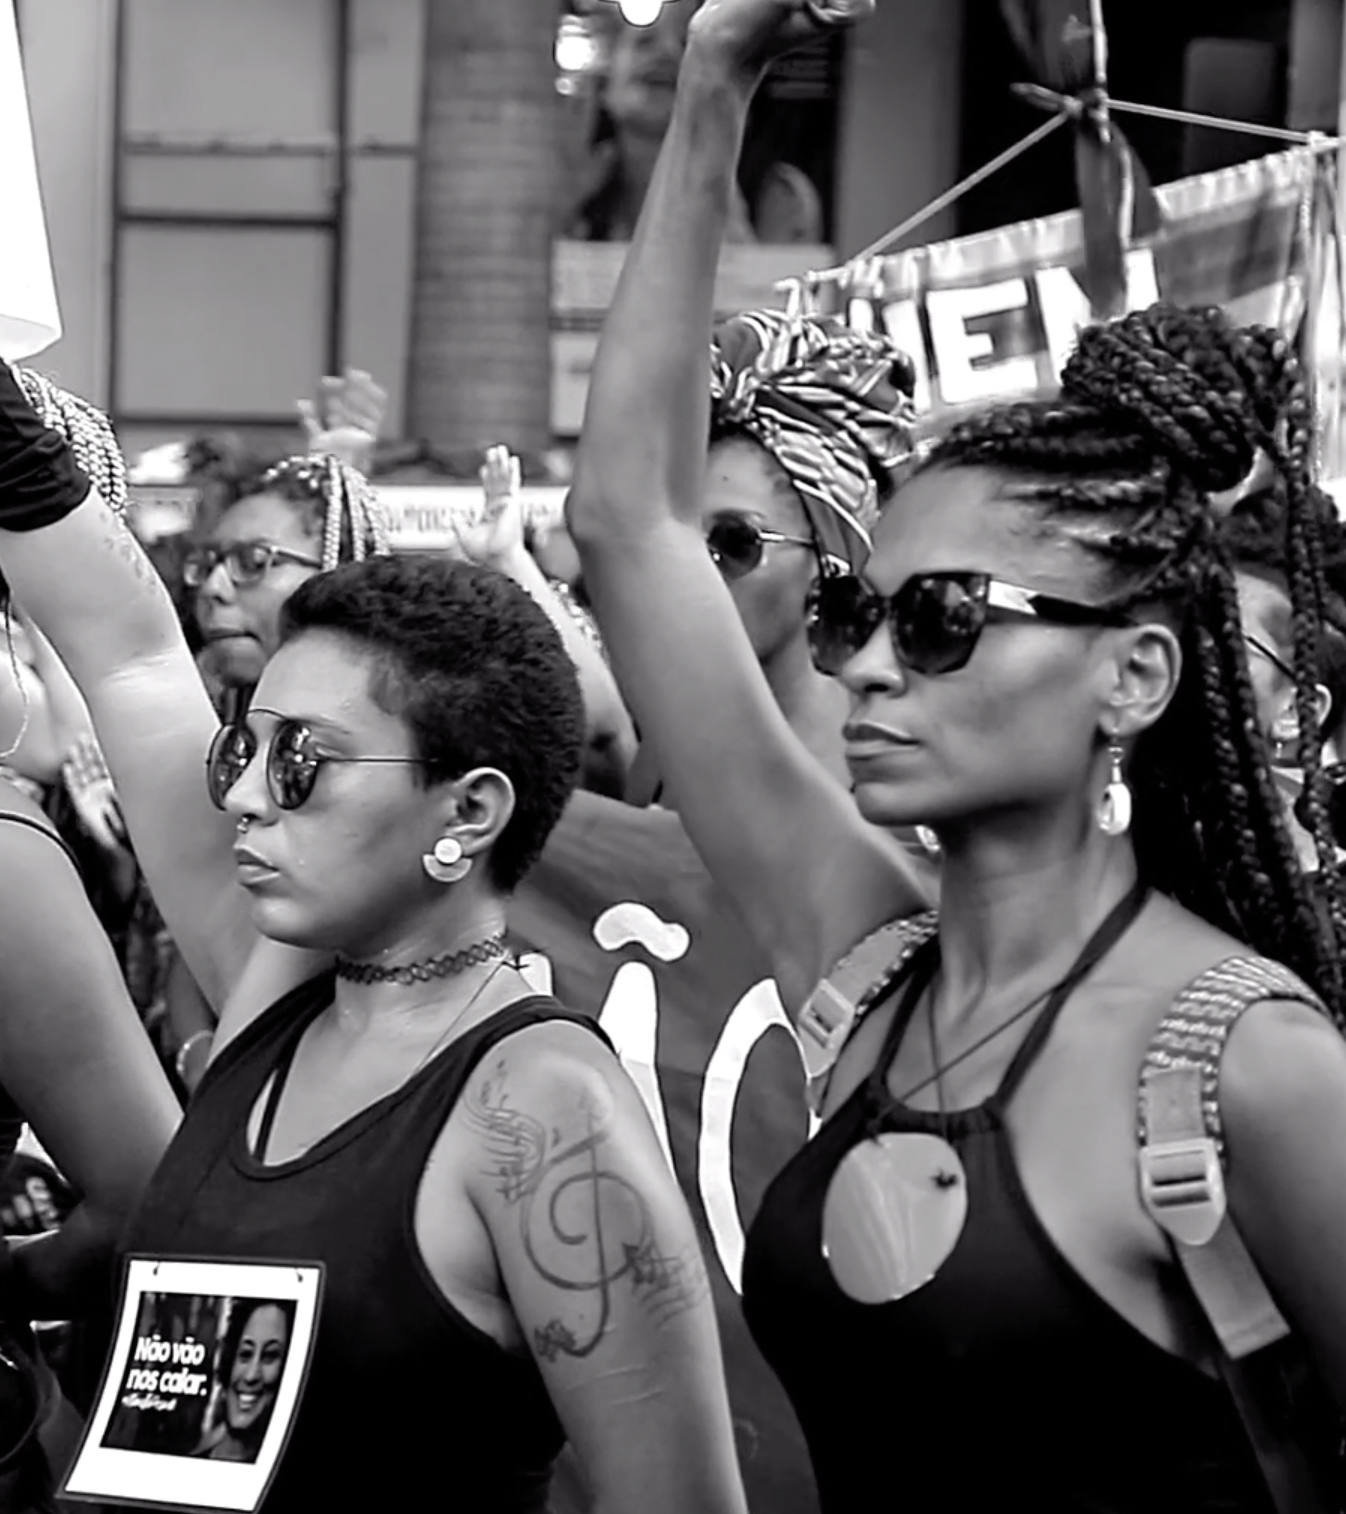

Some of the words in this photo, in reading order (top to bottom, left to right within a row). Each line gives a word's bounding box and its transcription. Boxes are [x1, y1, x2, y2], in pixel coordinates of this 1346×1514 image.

[134, 1334, 171, 1363] Não
[172, 1336, 205, 1366] vão
[126, 1369, 159, 1391] nos
[159, 1367, 207, 1396] calar.
